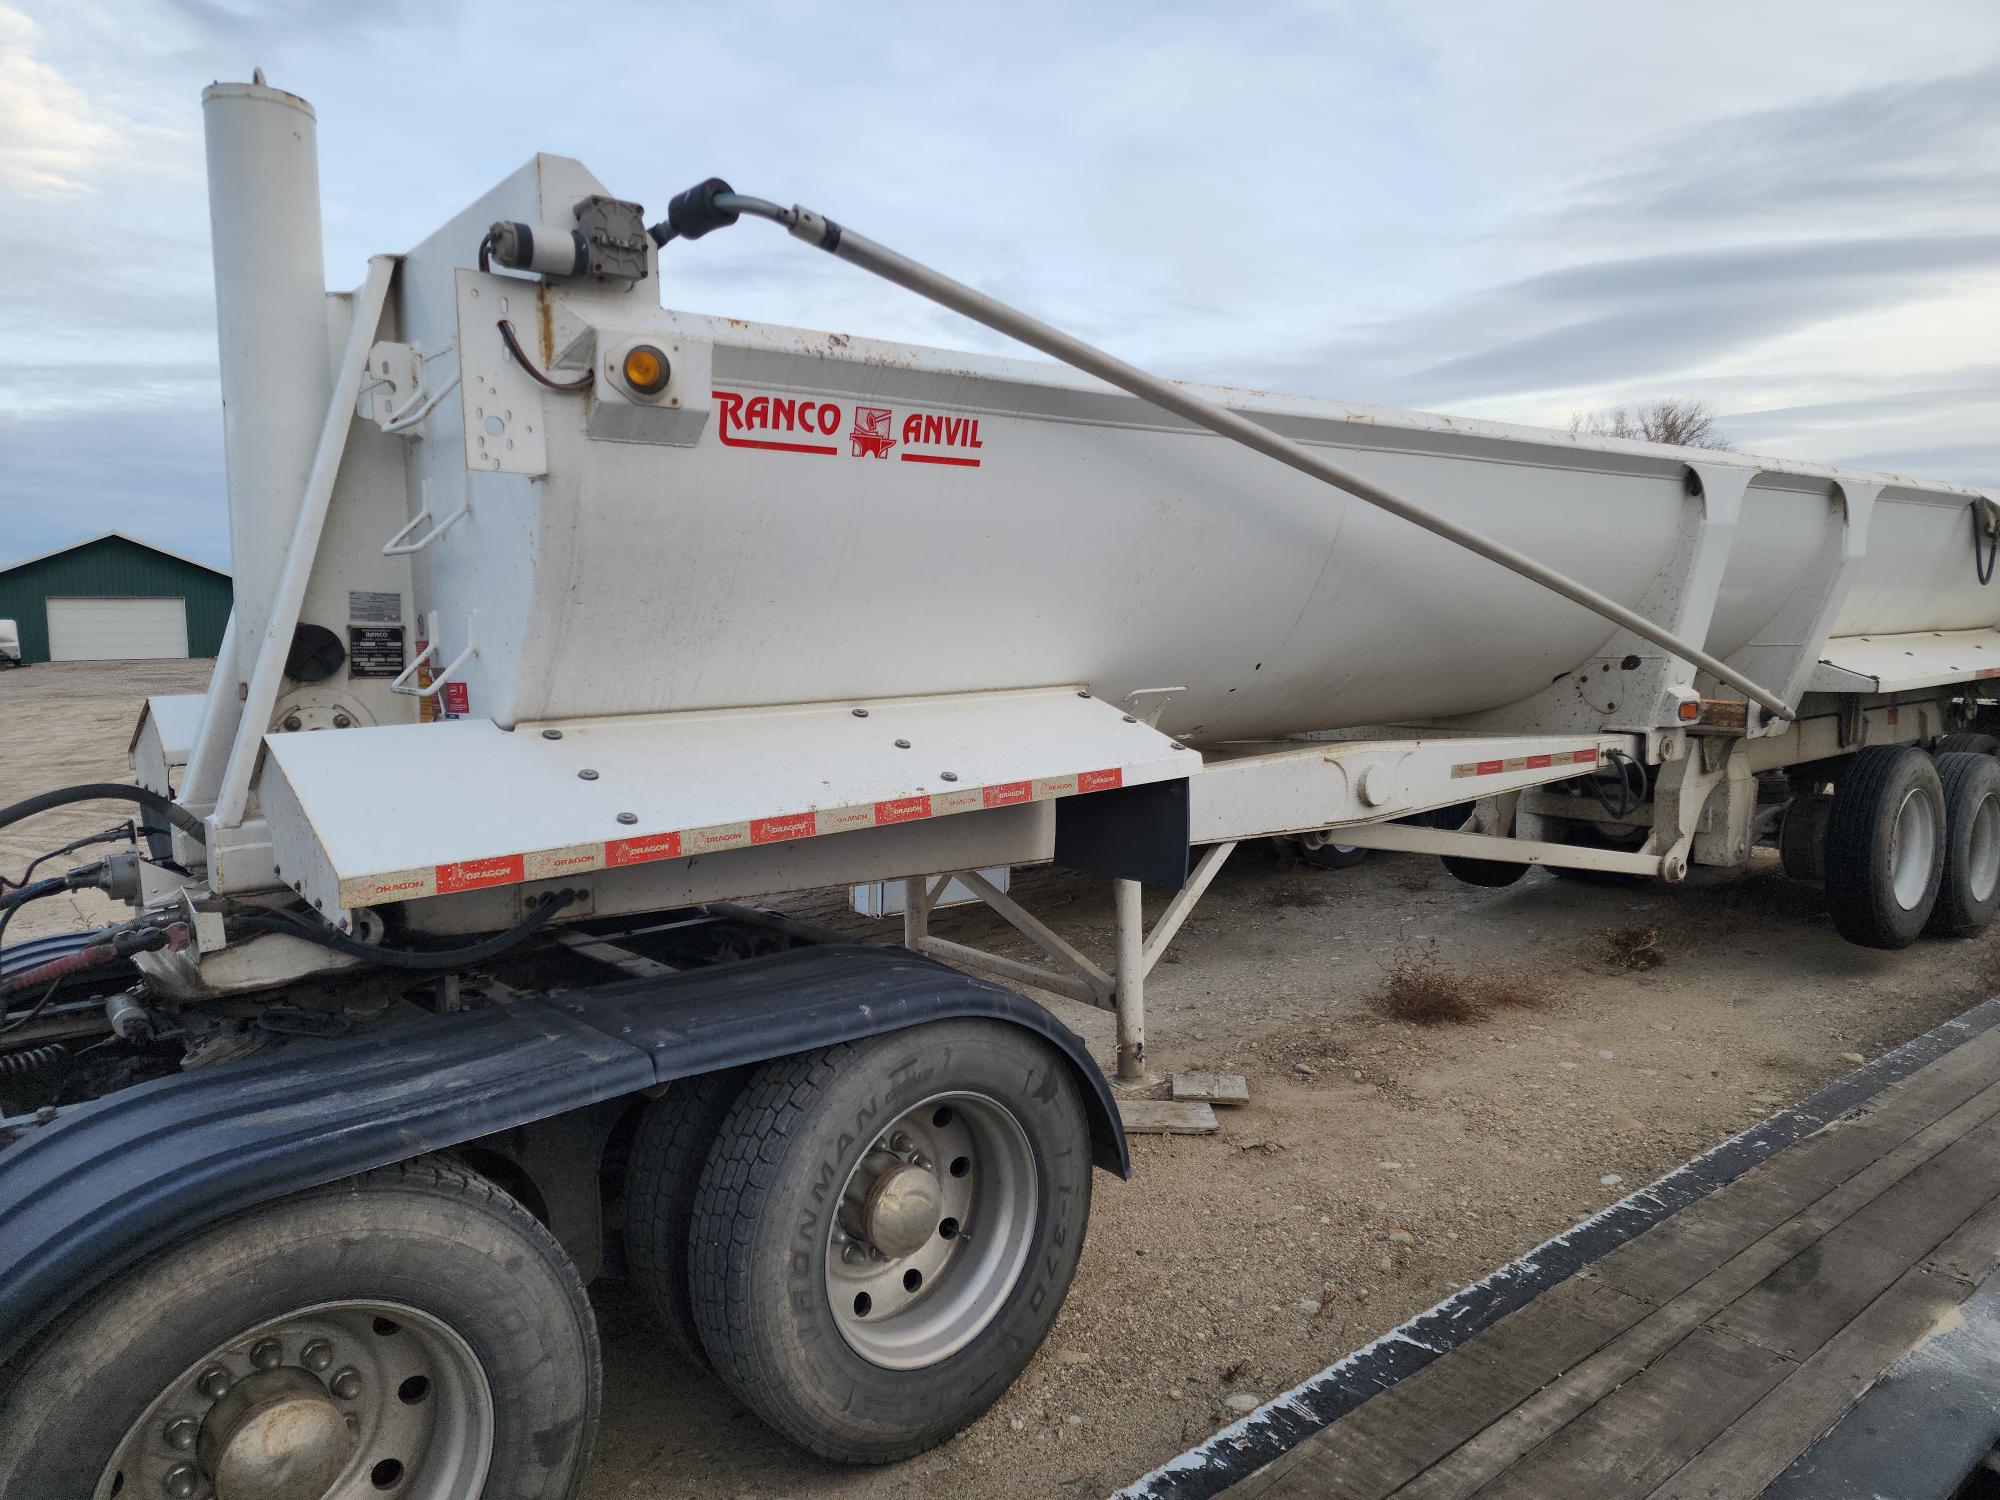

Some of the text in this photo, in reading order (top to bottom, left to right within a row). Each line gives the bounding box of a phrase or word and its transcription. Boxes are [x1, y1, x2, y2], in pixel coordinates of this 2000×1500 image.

[712, 391, 983, 448] RANCO ANVIL
[375, 880, 424, 894] DRAGON
[465, 867, 512, 881] DRAGON
[553, 855, 595, 867] DRAGON
[629, 843, 669, 856] DRAGON
[706, 833, 742, 844] DRAGON
[771, 822, 807, 834] DRAGON
[893, 805, 923, 815] DRAGON
[998, 788, 1025, 799] DRAGON
[1092, 776, 1116, 785] DRAGON
